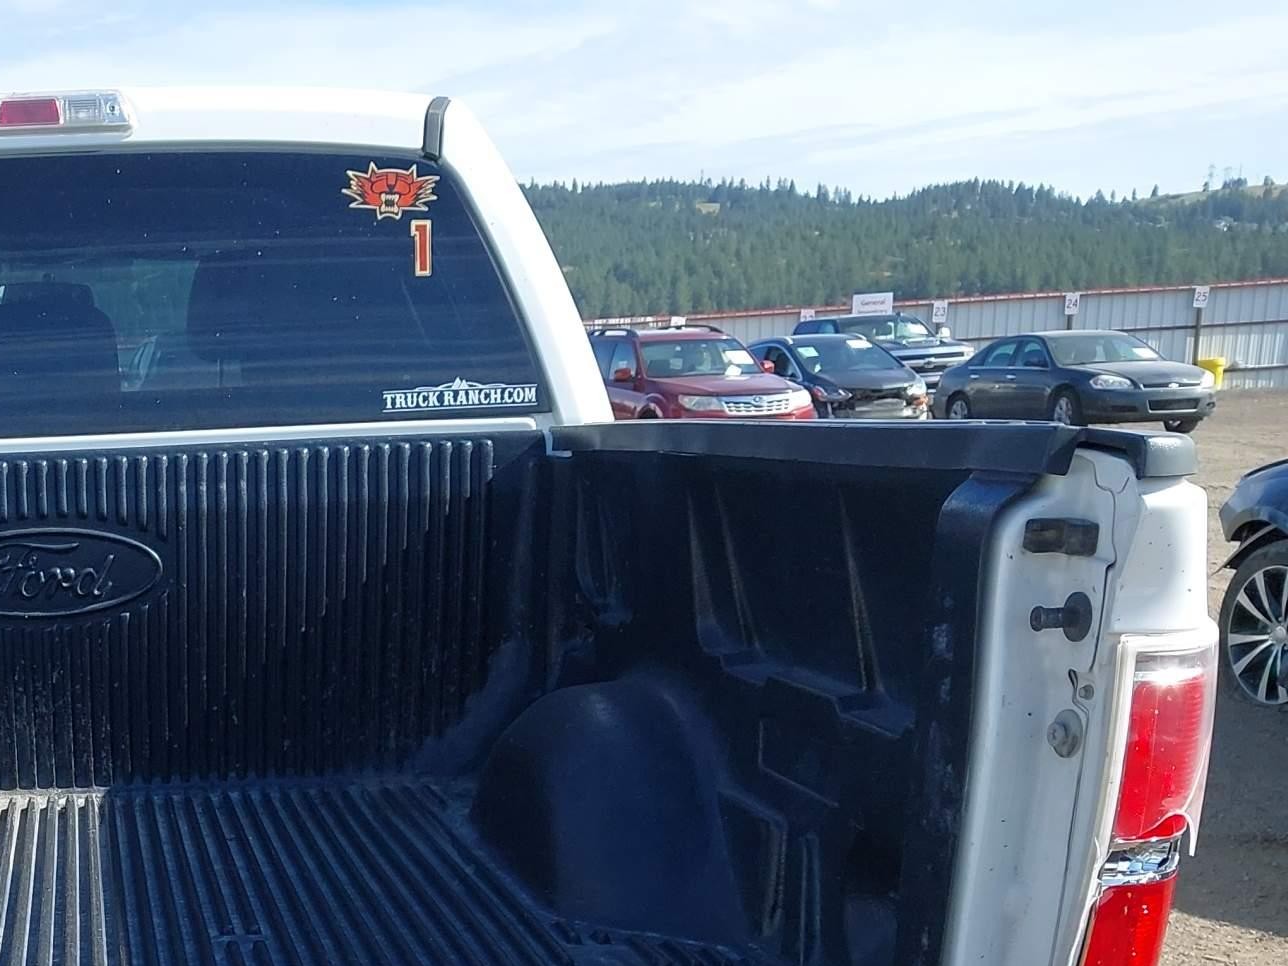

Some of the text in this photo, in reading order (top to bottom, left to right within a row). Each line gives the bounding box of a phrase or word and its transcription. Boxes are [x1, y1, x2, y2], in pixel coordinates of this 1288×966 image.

[411, 220, 431, 276] 1
[1195, 292, 1208, 302] 25
[1066, 298, 1078, 309] 24
[934, 306, 946, 317] 23
[383, 387, 537, 409] TRUCK RANCH.COM
